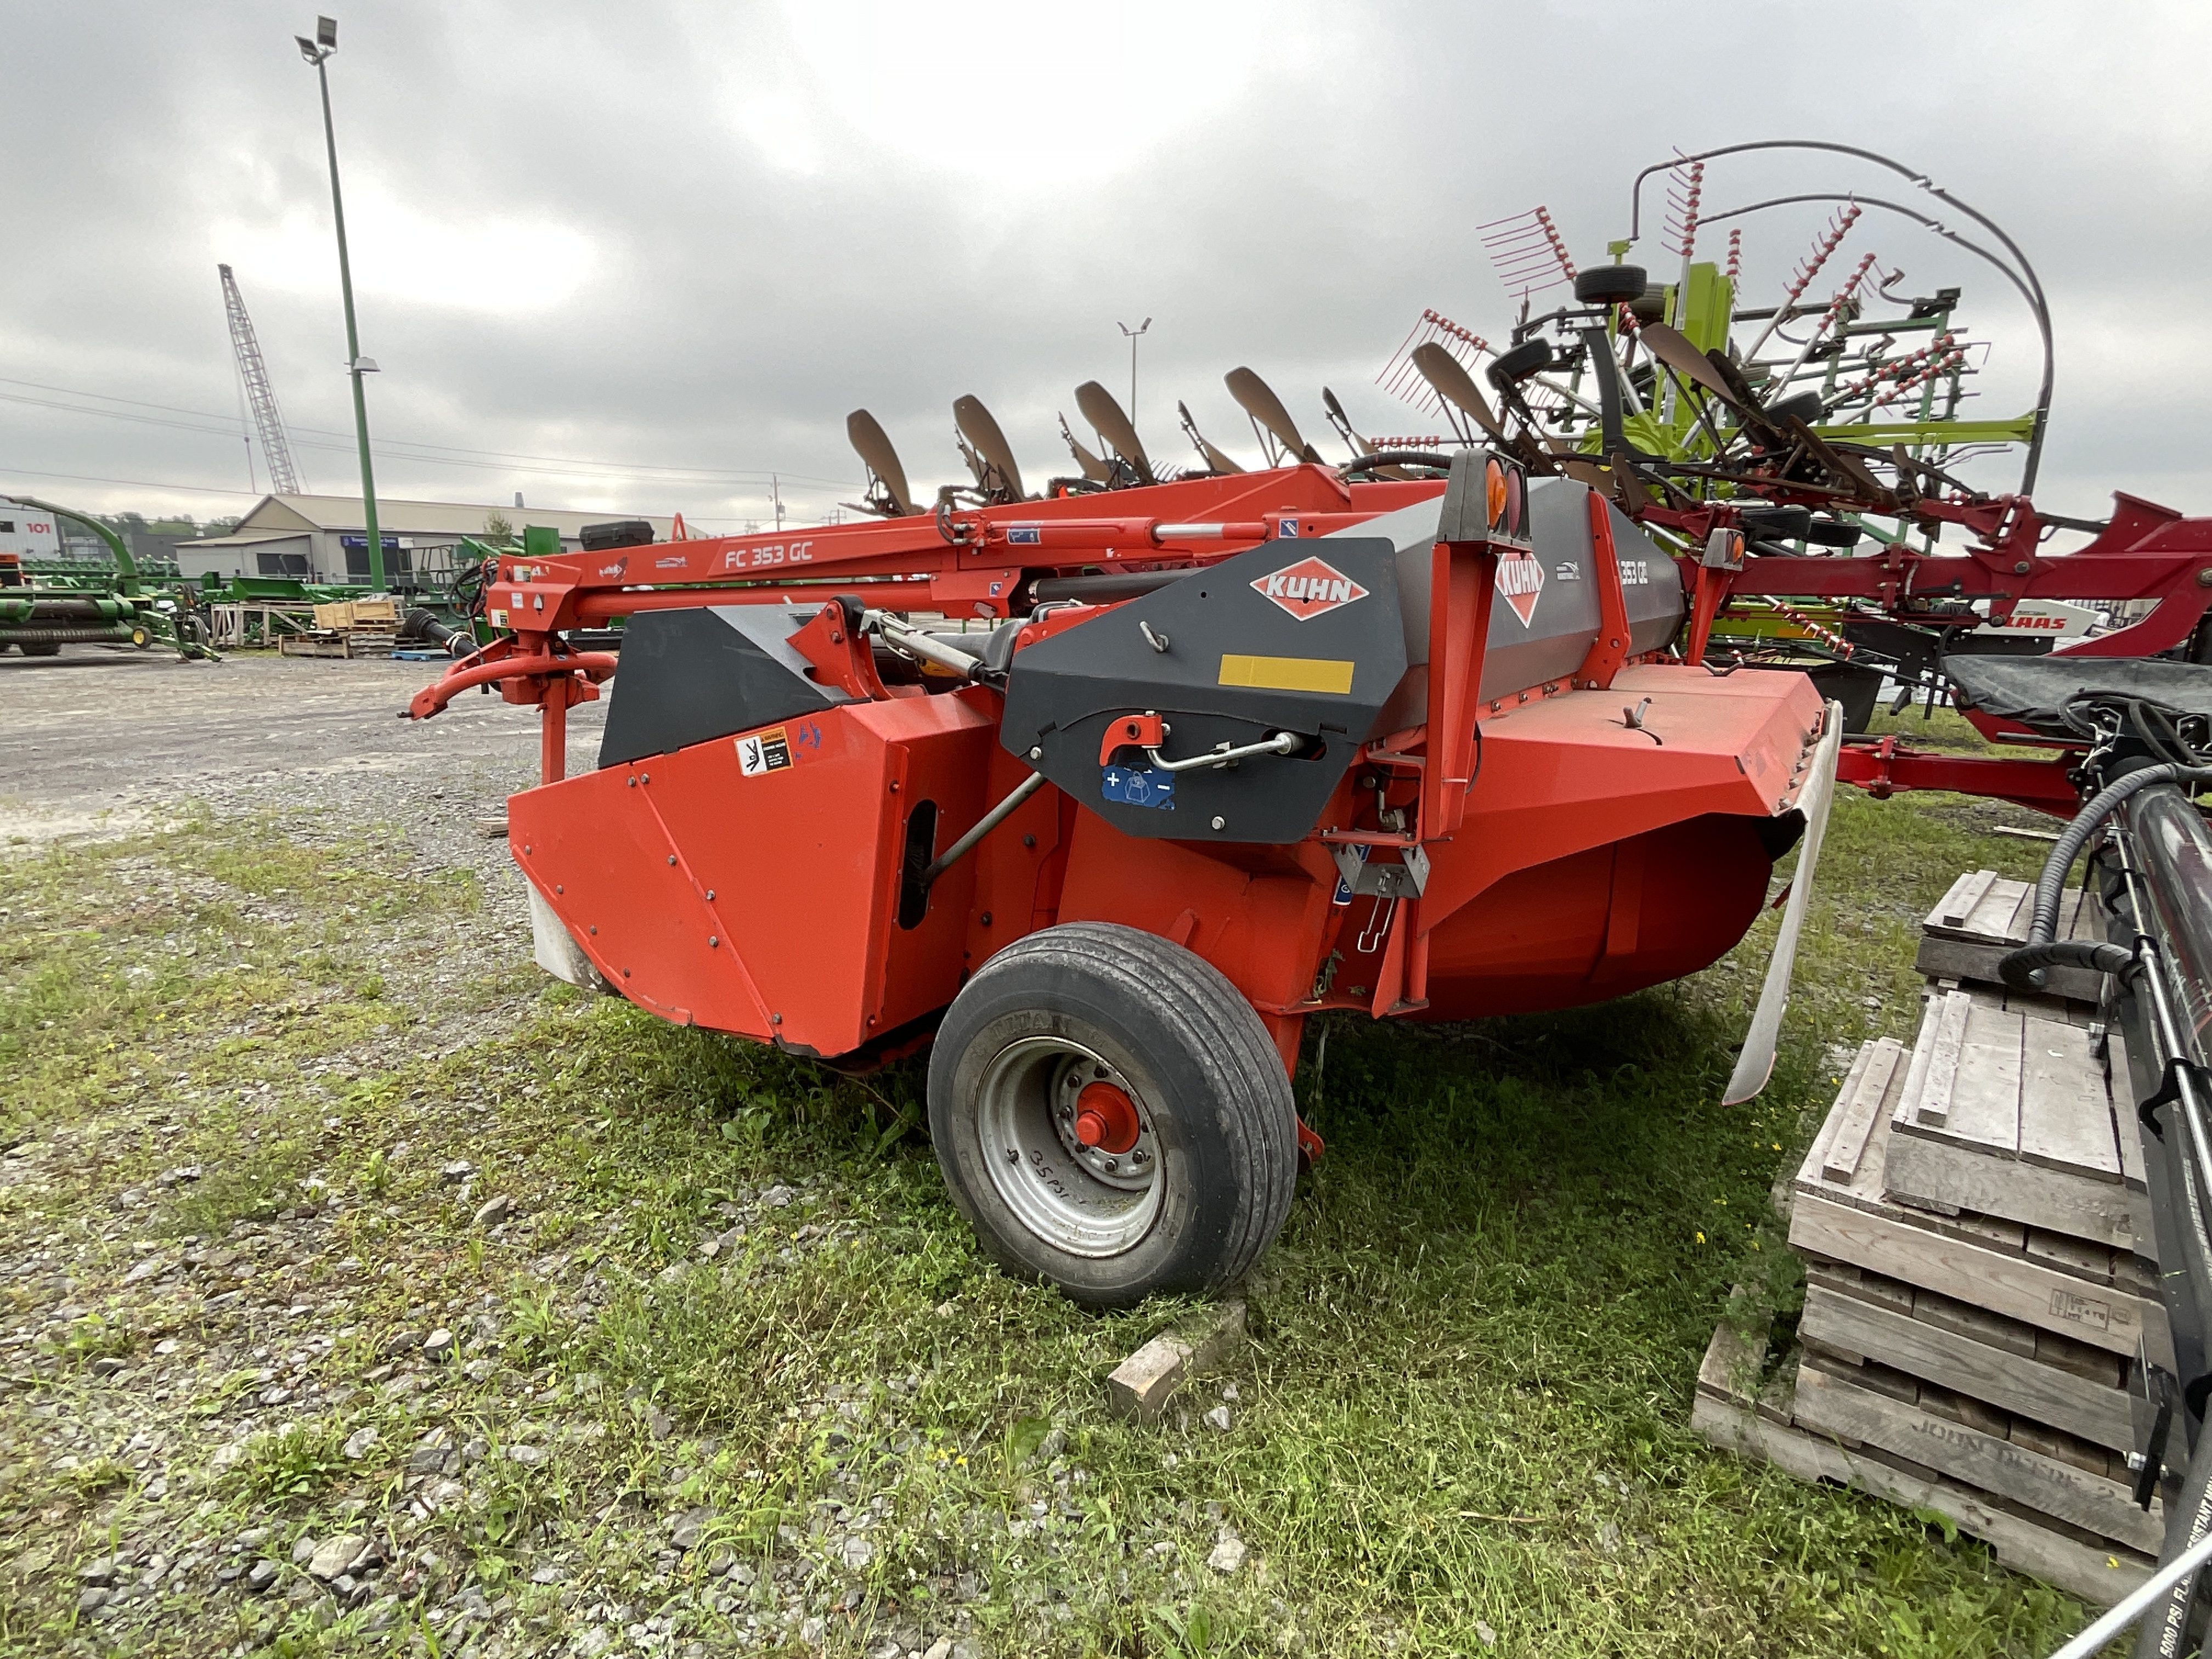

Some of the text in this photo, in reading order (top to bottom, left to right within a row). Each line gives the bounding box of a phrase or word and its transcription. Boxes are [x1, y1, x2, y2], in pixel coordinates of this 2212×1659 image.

[26, 523, 50, 534] 101
[725, 541, 813, 569] FC 353 GC
[1500, 560, 1541, 596] KUHN
[1621, 561, 1637, 585] 353
[1266, 575, 1352, 602] KUHN
[2004, 617, 2068, 629] LAAS
[990, 1011, 1071, 1039] TITAN
[1909, 1420, 1984, 1453] JOHN
[2166, 1602, 2184, 1629] PSI
[2159, 1626, 2178, 1658] 5000
